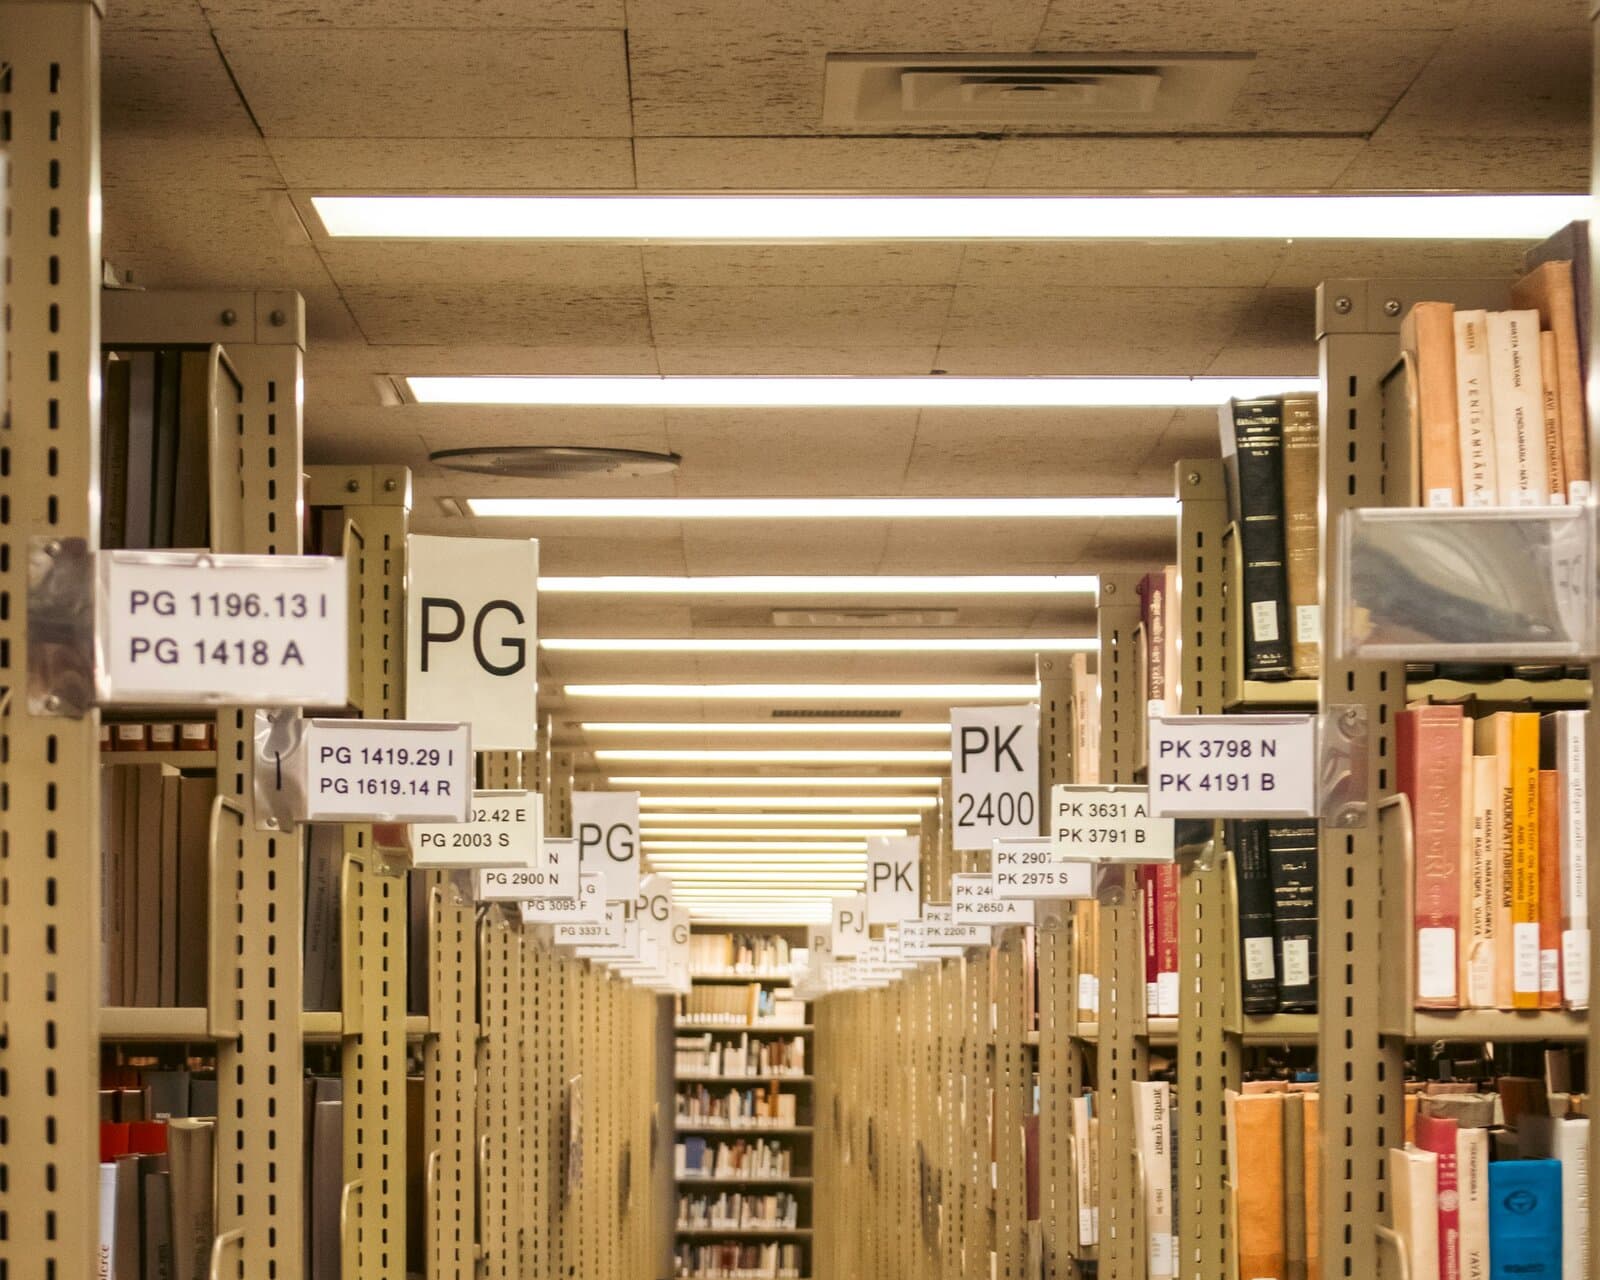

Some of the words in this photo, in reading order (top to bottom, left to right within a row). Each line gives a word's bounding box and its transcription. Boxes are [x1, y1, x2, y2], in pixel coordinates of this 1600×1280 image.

[130, 589, 176, 616] PG
[191, 593, 308, 619] 1196.13
[420, 596, 526, 677] PG
[130, 637, 179, 665] PG
[195, 640, 269, 666] 1418
[281, 640, 304, 666] A
[320, 746, 352, 765] PG
[361, 747, 440, 767] 1419.29
[960, 724, 1024, 774] PK
[1160, 740, 1191, 758] PK
[1199, 739, 1252, 759] 3798
[1261, 739, 1276, 758] N
[320, 777, 349, 794] PG
[357, 778, 430, 796] 1619.14
[437, 780, 451, 796] R
[1160, 773, 1191, 792] PK
[1199, 773, 1249, 792] 4191
[1261, 772, 1275, 792] B
[515, 808, 526, 822] E
[957, 791, 1034, 827] 2400
[1059, 802, 1083, 817] PK
[1089, 803, 1126, 818] 3631
[1134, 804, 1147, 818] A
[420, 833, 446, 848] PG
[452, 833, 492, 848] 2003
[498, 832, 510, 847] S
[581, 822, 634, 863] PG
[1059, 828, 1083, 843] PK
[1088, 828, 1126, 843] 3791
[1135, 829, 1146, 844] B
[549, 853, 559, 865] N
[998, 852, 1017, 865] PK
[486, 872, 507, 885] PG
[512, 872, 545, 885] 2900
[549, 873, 559, 885] N
[873, 861, 913, 893] PK
[998, 873, 1017, 885] PK
[1022, 872, 1054, 885] 2975
[1058, 872, 1069, 885] S
[956, 886, 973, 895] PK
[526, 900, 545, 911] PG
[633, 894, 669, 922] PG
[956, 902, 973, 913] PK
[976, 903, 1004, 913] 2650
[1007, 903, 1016, 913] A
[839, 910, 865, 934] PJ
[927, 927, 941, 936] PK
[671, 923, 689, 945] G
